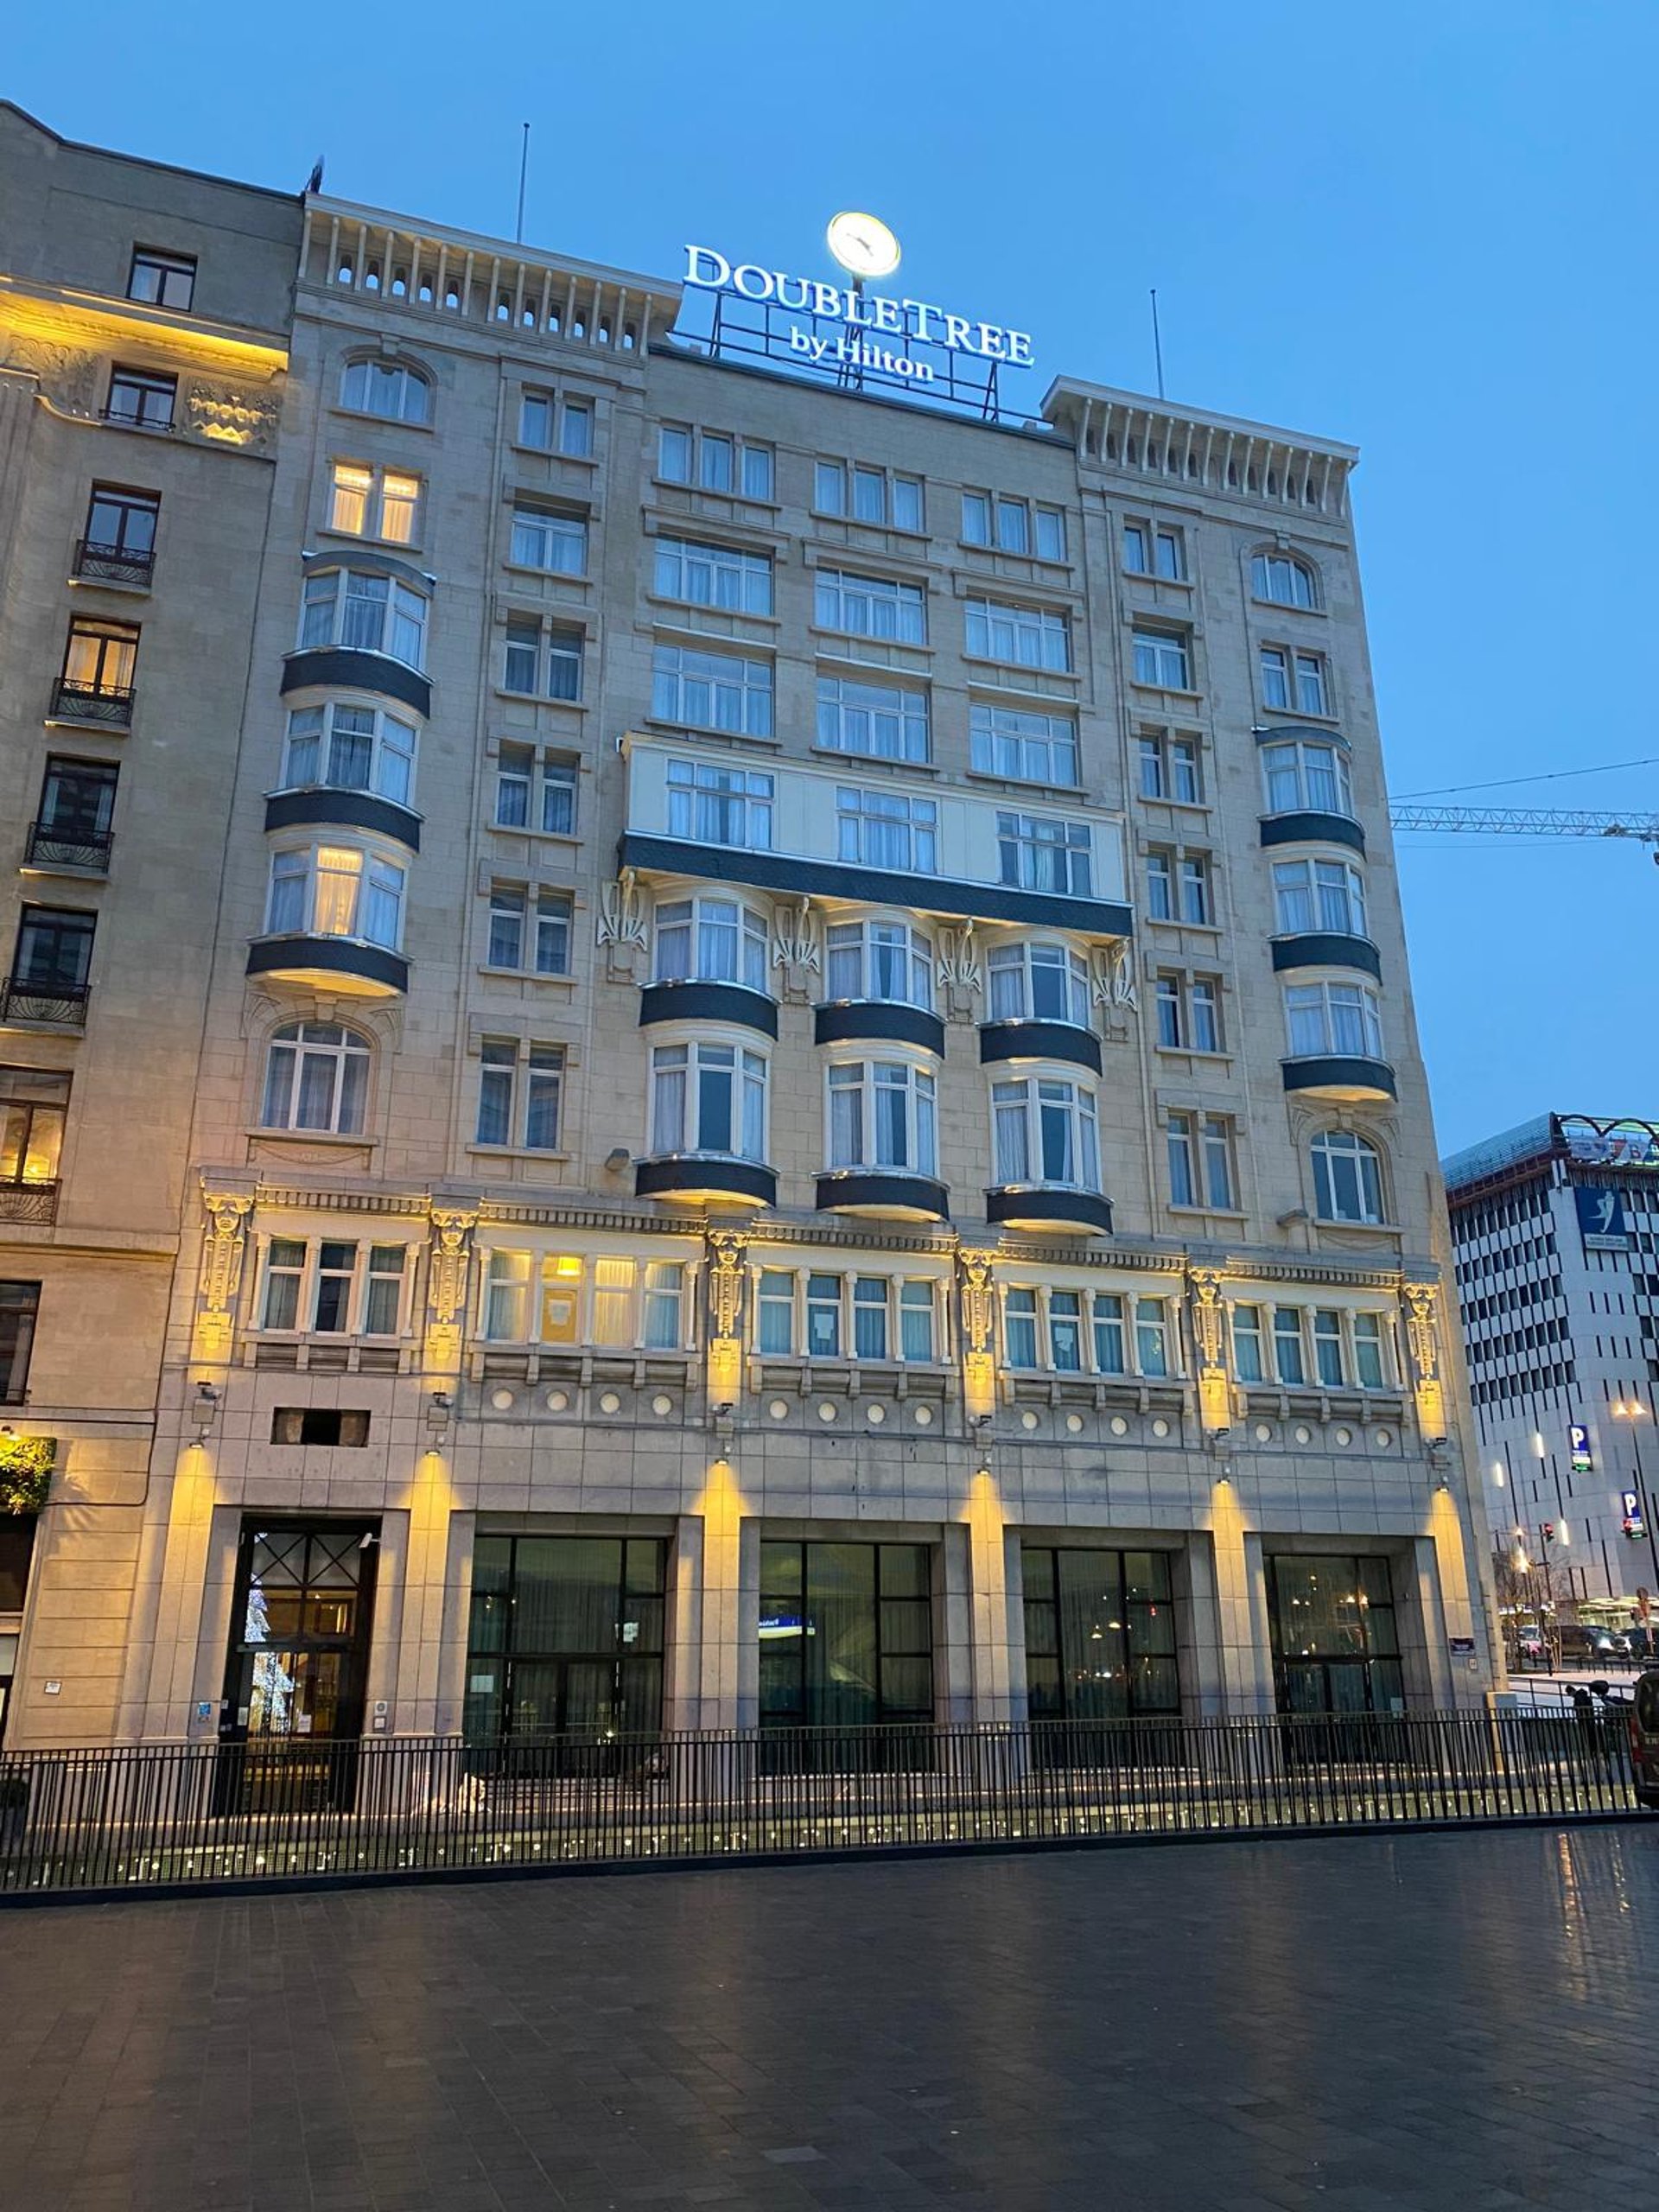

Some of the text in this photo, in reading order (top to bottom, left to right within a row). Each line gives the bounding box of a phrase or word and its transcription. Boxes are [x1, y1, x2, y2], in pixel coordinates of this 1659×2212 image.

[683, 244, 1036, 369] DOUBLETREE
[789, 325, 935, 382] by Hilton
[1570, 1427, 1585, 1449] P
[1624, 1493, 1637, 1516] P
